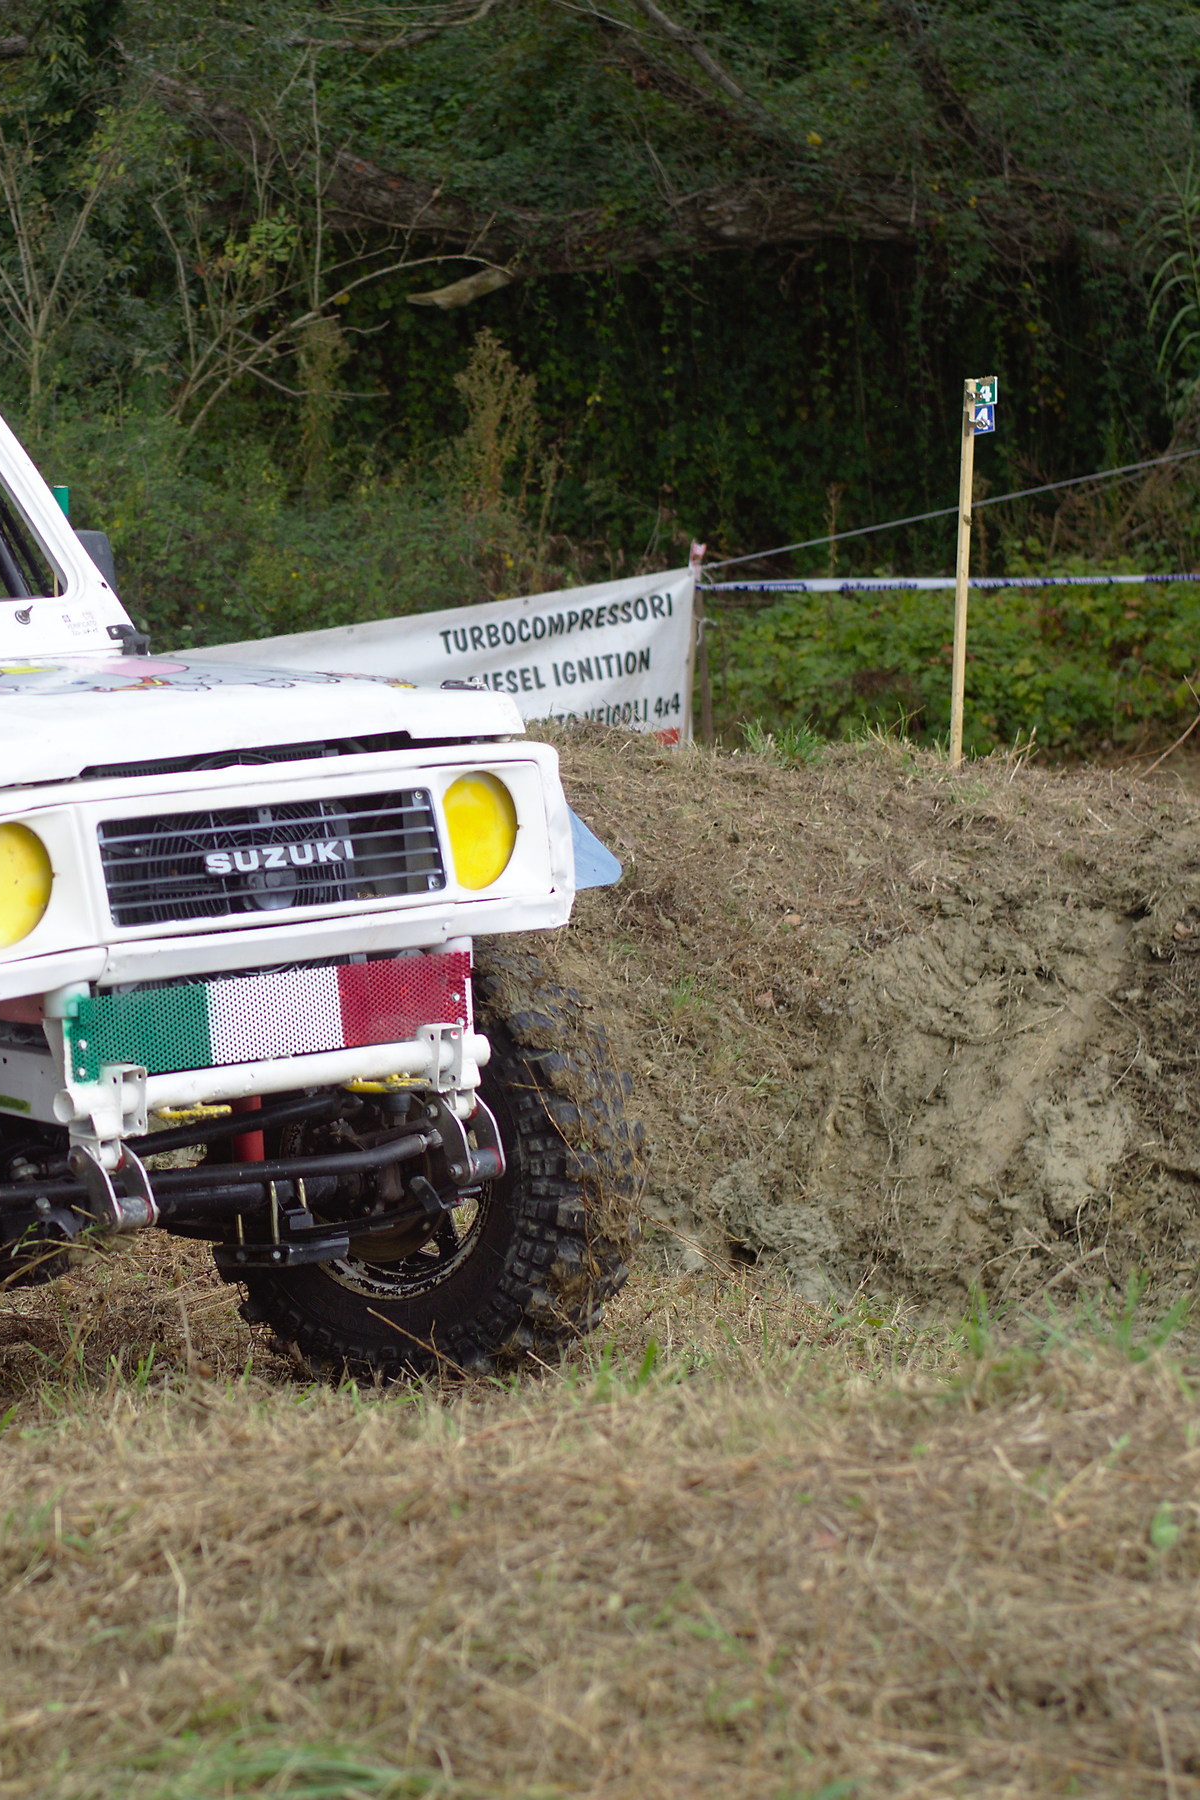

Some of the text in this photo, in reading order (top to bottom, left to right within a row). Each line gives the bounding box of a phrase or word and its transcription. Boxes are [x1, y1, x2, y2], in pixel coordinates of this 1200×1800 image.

[439, 593, 673, 654] TURBOCOMPRESSORI
[552, 647, 651, 687] IGNITION
[654, 693, 680, 719] 4x4
[205, 839, 355, 875] SUZUKI
